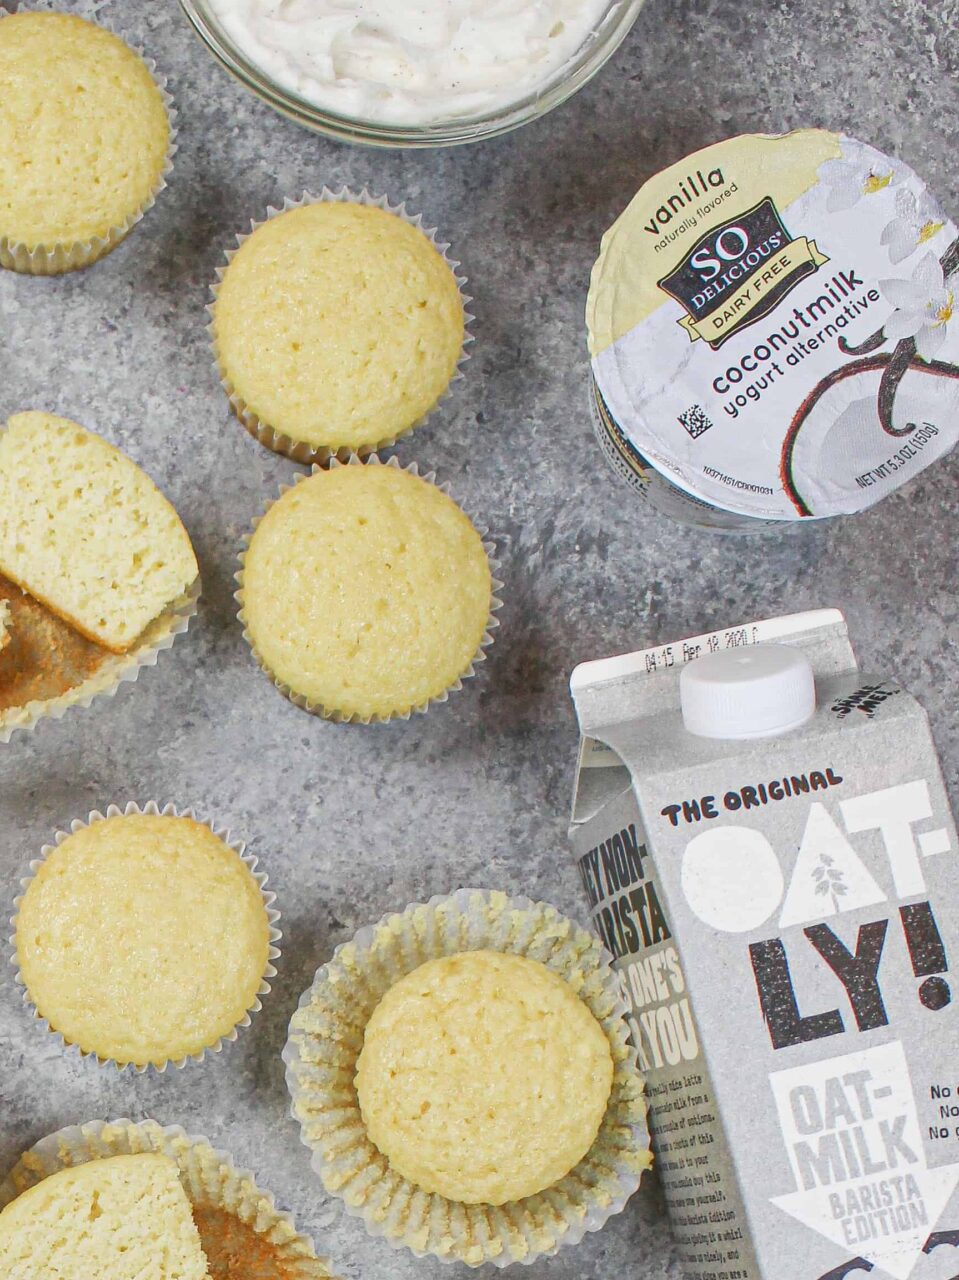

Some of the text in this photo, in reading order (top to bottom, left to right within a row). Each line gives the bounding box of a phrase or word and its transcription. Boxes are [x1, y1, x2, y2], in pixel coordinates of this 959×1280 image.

[644, 168, 725, 236] vanilla
[654, 182, 738, 254] naturally flavored
[690, 226, 749, 283] SO
[691, 234, 781, 310] DELICIOUS
[712, 256, 792, 329] DAIRY FREE
[712, 268, 864, 395] coconutmilk
[723, 287, 880, 419] yogurt alternative
[855, 422, 939, 489] NET WT 5.3 OZ (150g)
[661, 768, 843, 826] THE ORIGINAL
[599, 824, 648, 896] NON-
[681, 779, 951, 932] OAT-
[593, 881, 671, 958] RISTA
[628, 946, 685, 1008] ONE'S
[749, 901, 952, 1049] LY!
[640, 998, 698, 1069] YOU
[789, 1070, 892, 1135] OAT-
[930, 1085, 951, 1100] No
[939, 1106, 959, 1119] No
[793, 1115, 918, 1191] MILK
[929, 1127, 950, 1140] No
[828, 1173, 923, 1220] BARISTA
[841, 1200, 929, 1245] EDITION
